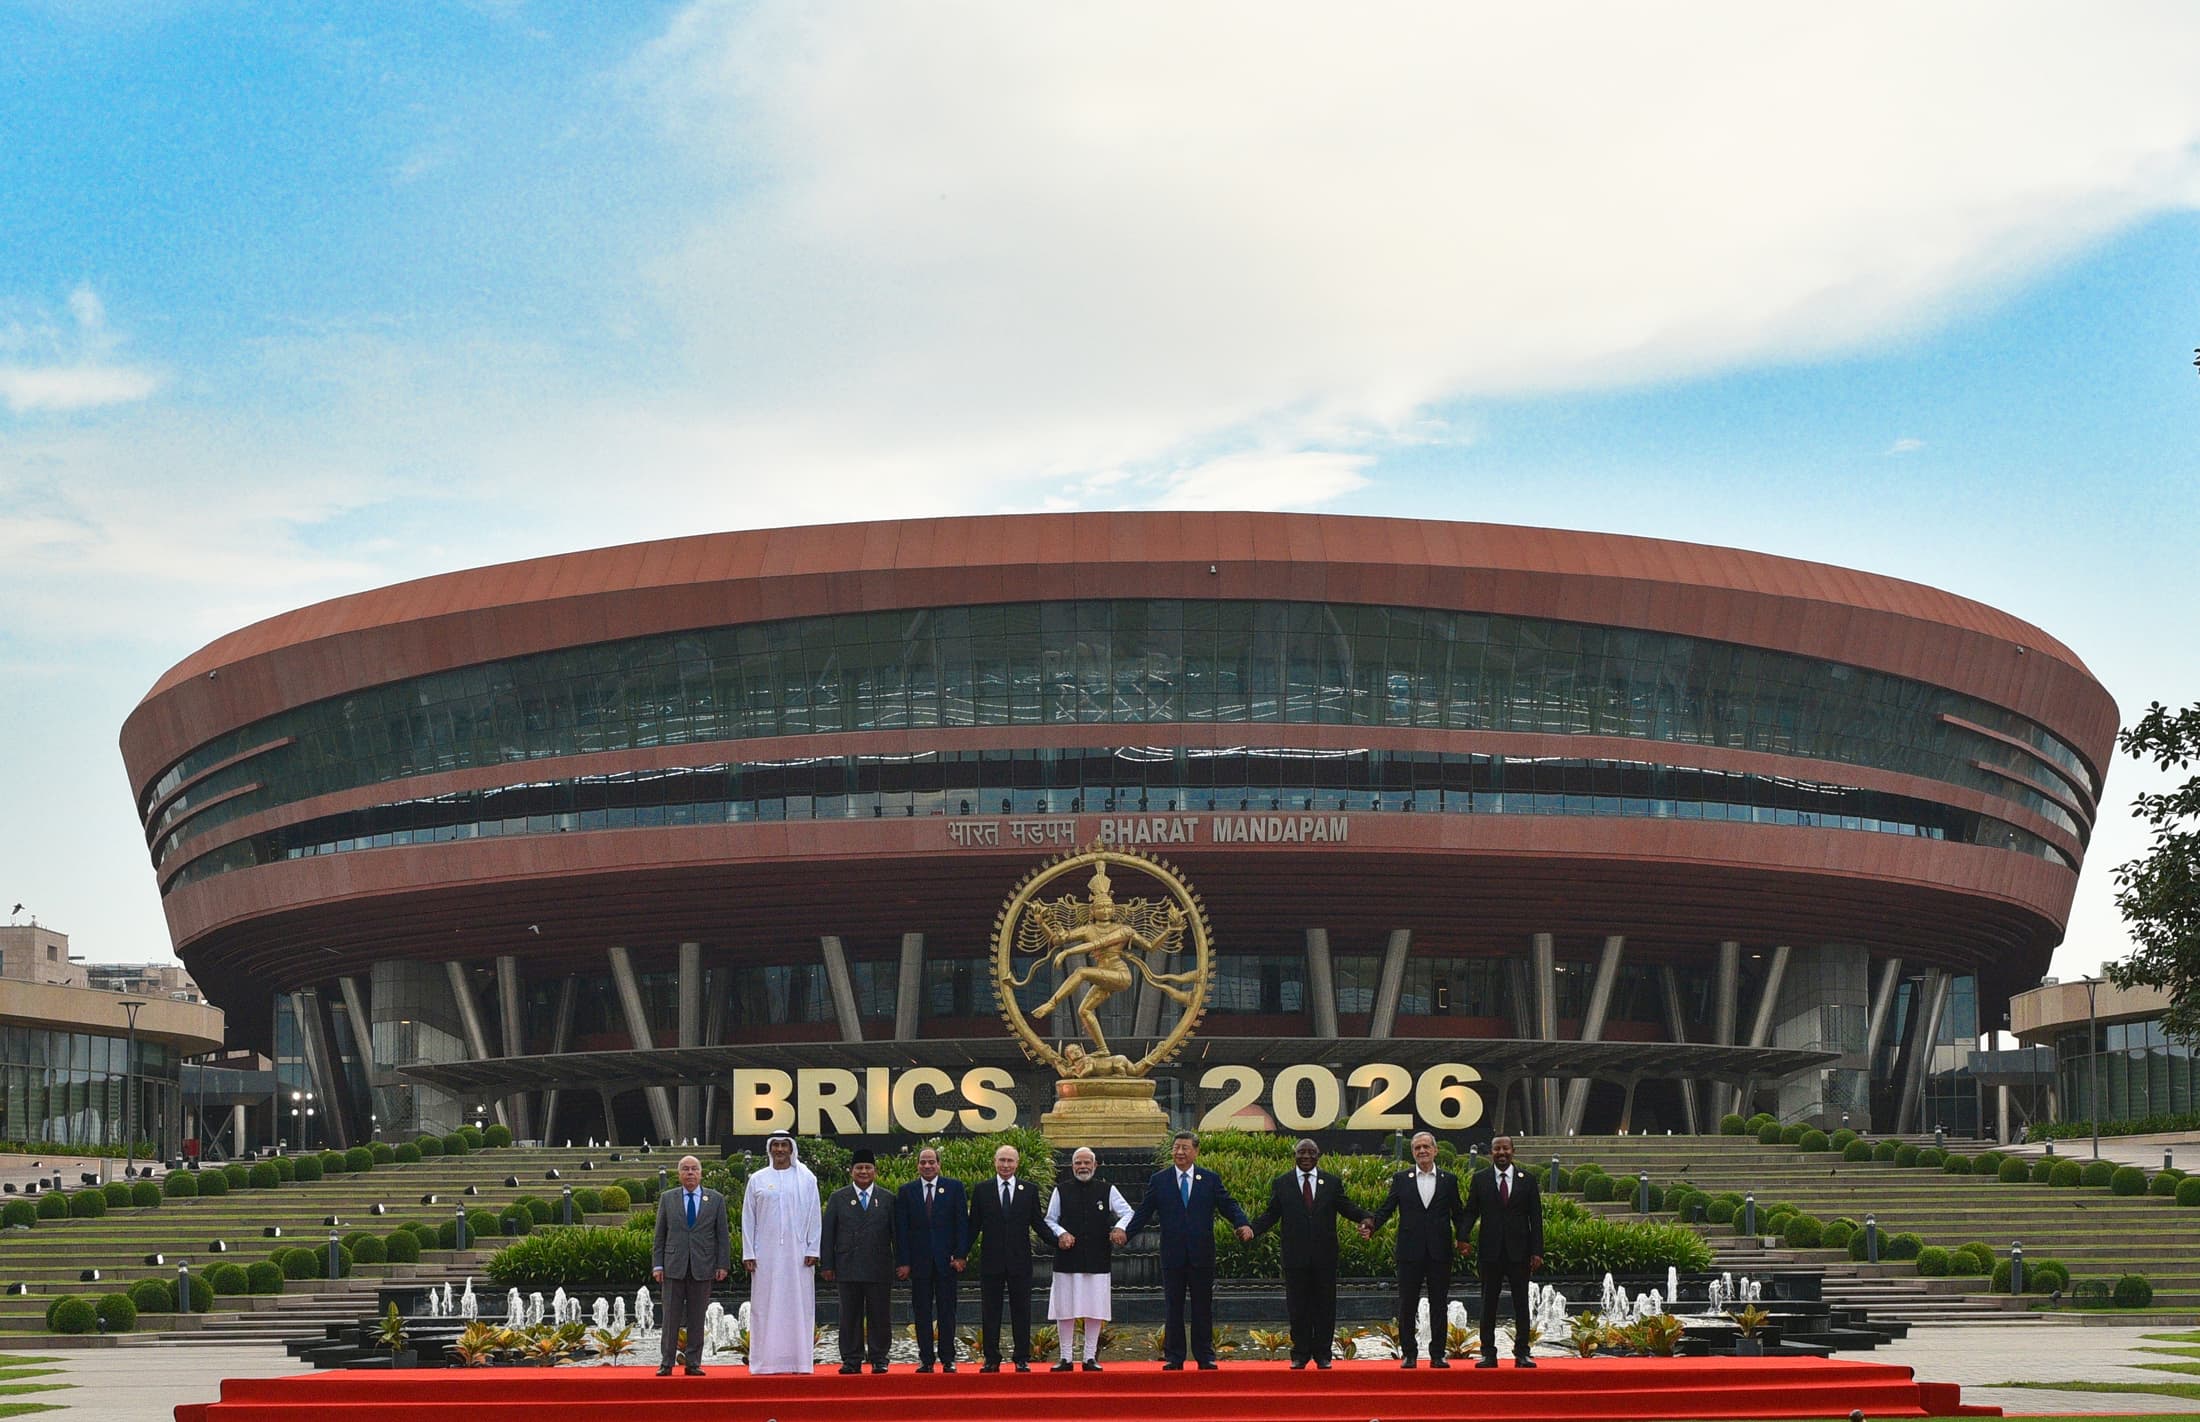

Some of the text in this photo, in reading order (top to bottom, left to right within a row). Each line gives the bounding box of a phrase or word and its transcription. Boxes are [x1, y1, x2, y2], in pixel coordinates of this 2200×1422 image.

[948, 820, 999, 847] भारत
[1100, 817, 1348, 844] BHARAT MANDAPAM
[732, 1063, 1484, 1135] BRICS 2026
